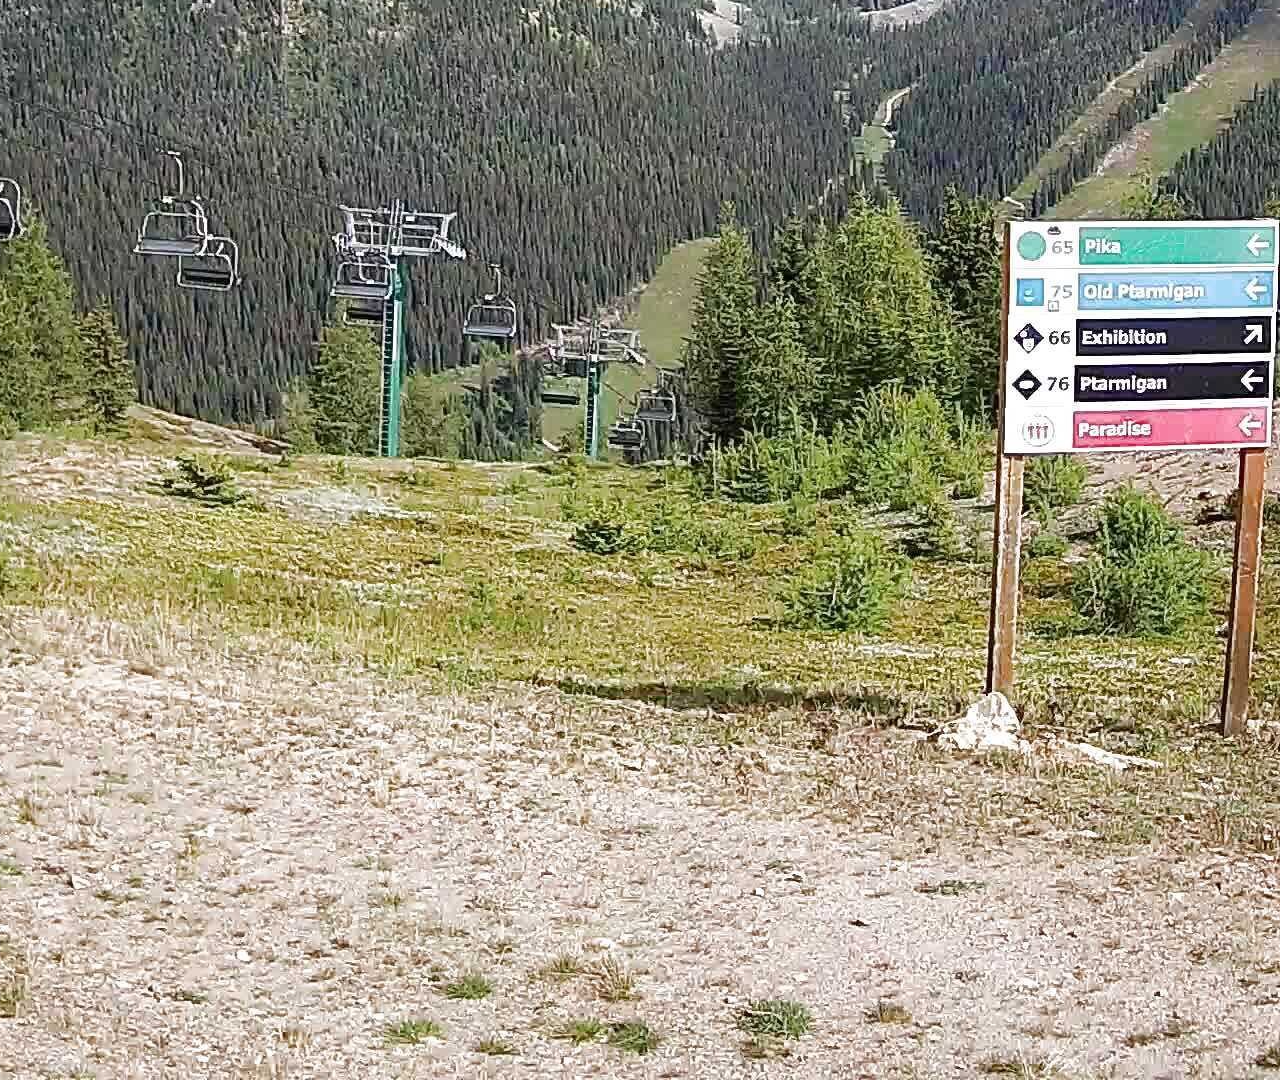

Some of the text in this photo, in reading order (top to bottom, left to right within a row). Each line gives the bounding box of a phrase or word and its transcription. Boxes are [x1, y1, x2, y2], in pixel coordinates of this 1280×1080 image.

[1051, 238, 1121, 254] 65 Pika
[1050, 283, 1205, 301] 75 Old Ptarmigan
[1048, 329, 1167, 345] 66 Exhibition
[1047, 375, 1168, 394] 76 Ptarmigan
[1078, 420, 1152, 438] Paradise
